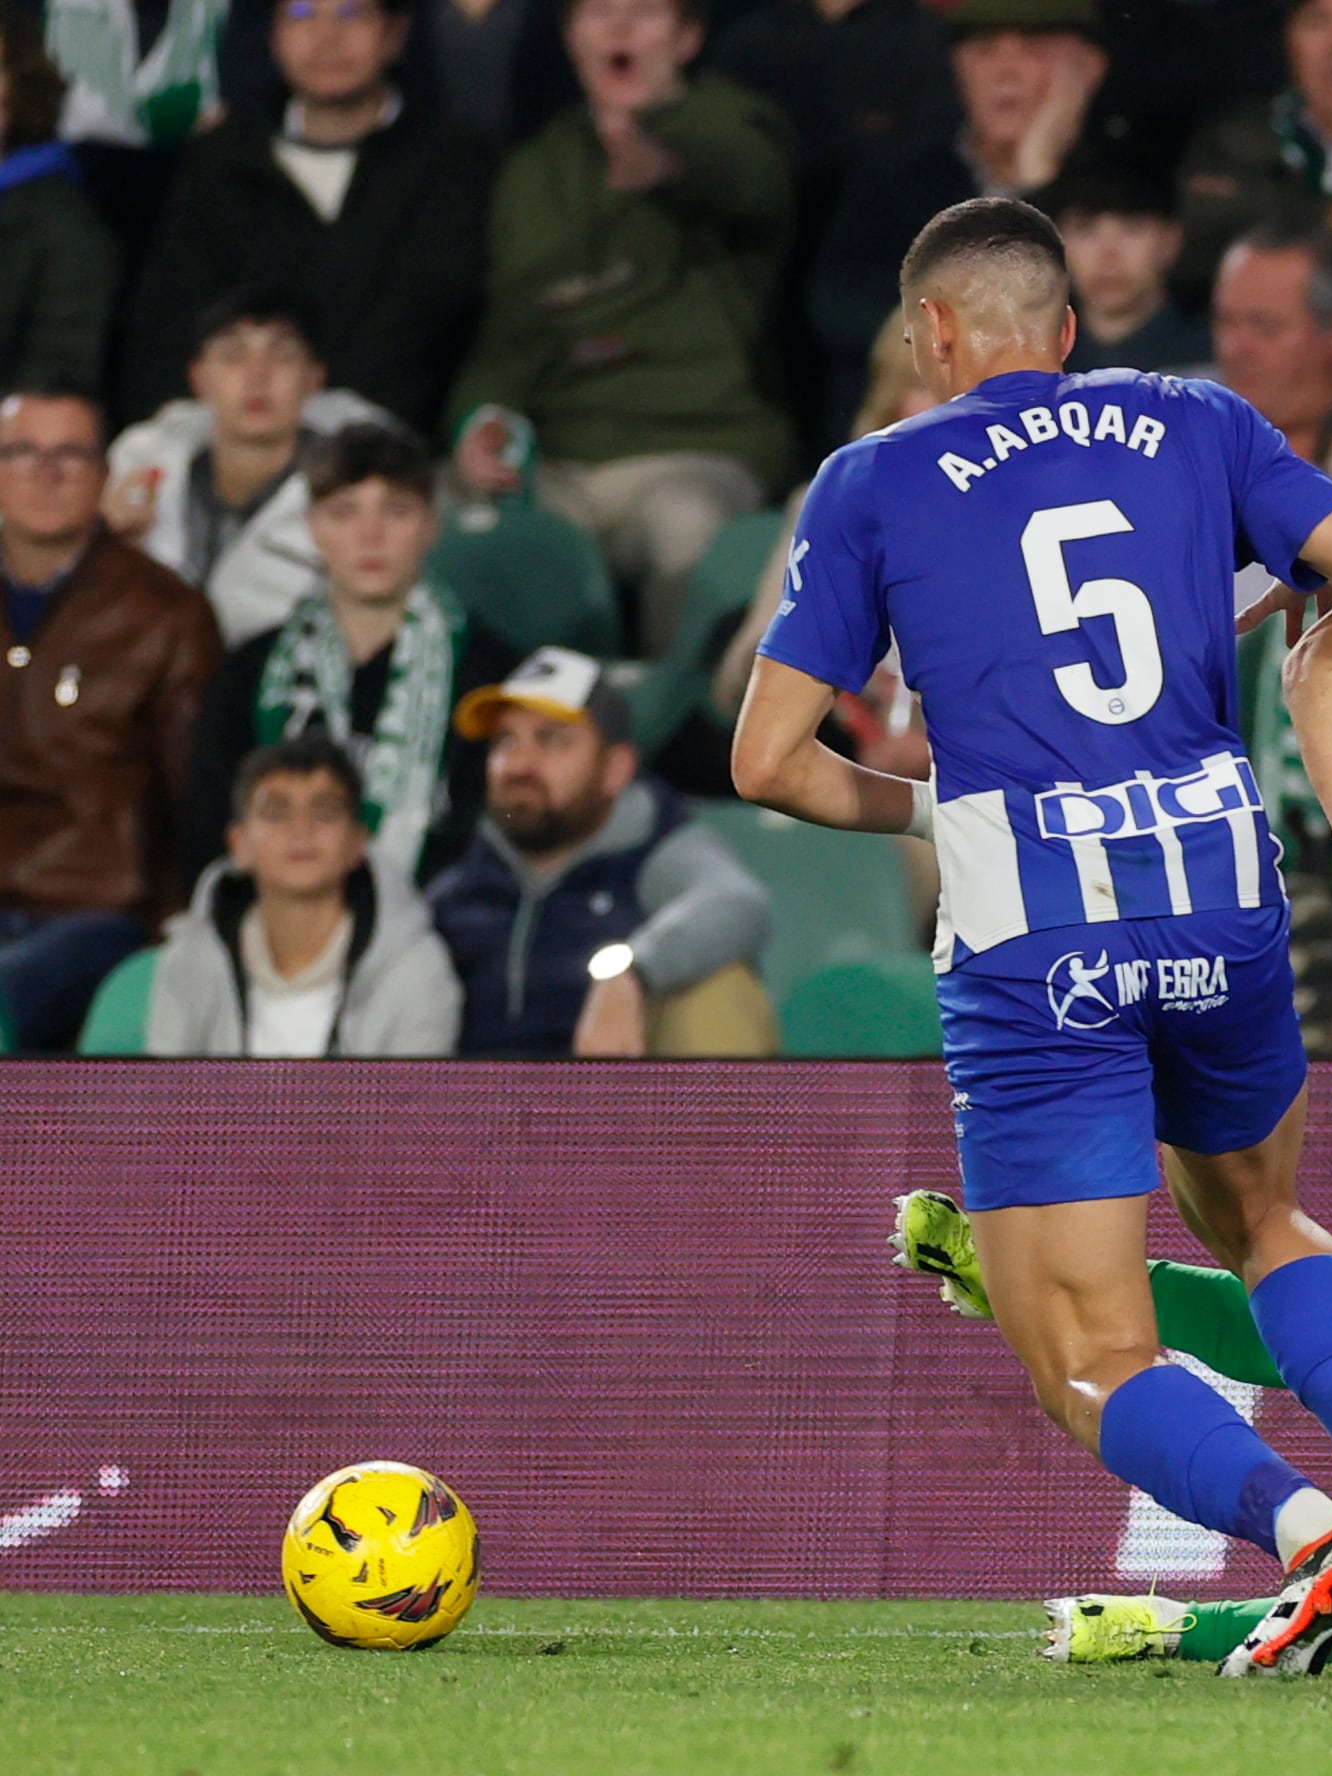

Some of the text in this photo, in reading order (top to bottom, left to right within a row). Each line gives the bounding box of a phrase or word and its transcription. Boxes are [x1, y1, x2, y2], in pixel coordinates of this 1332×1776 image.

[937, 400, 1166, 493] A.ABQAR
[1020, 499, 1164, 725] 5
[1035, 757, 1264, 839] DIGI
[1114, 955, 1229, 1007] INTEGRA
